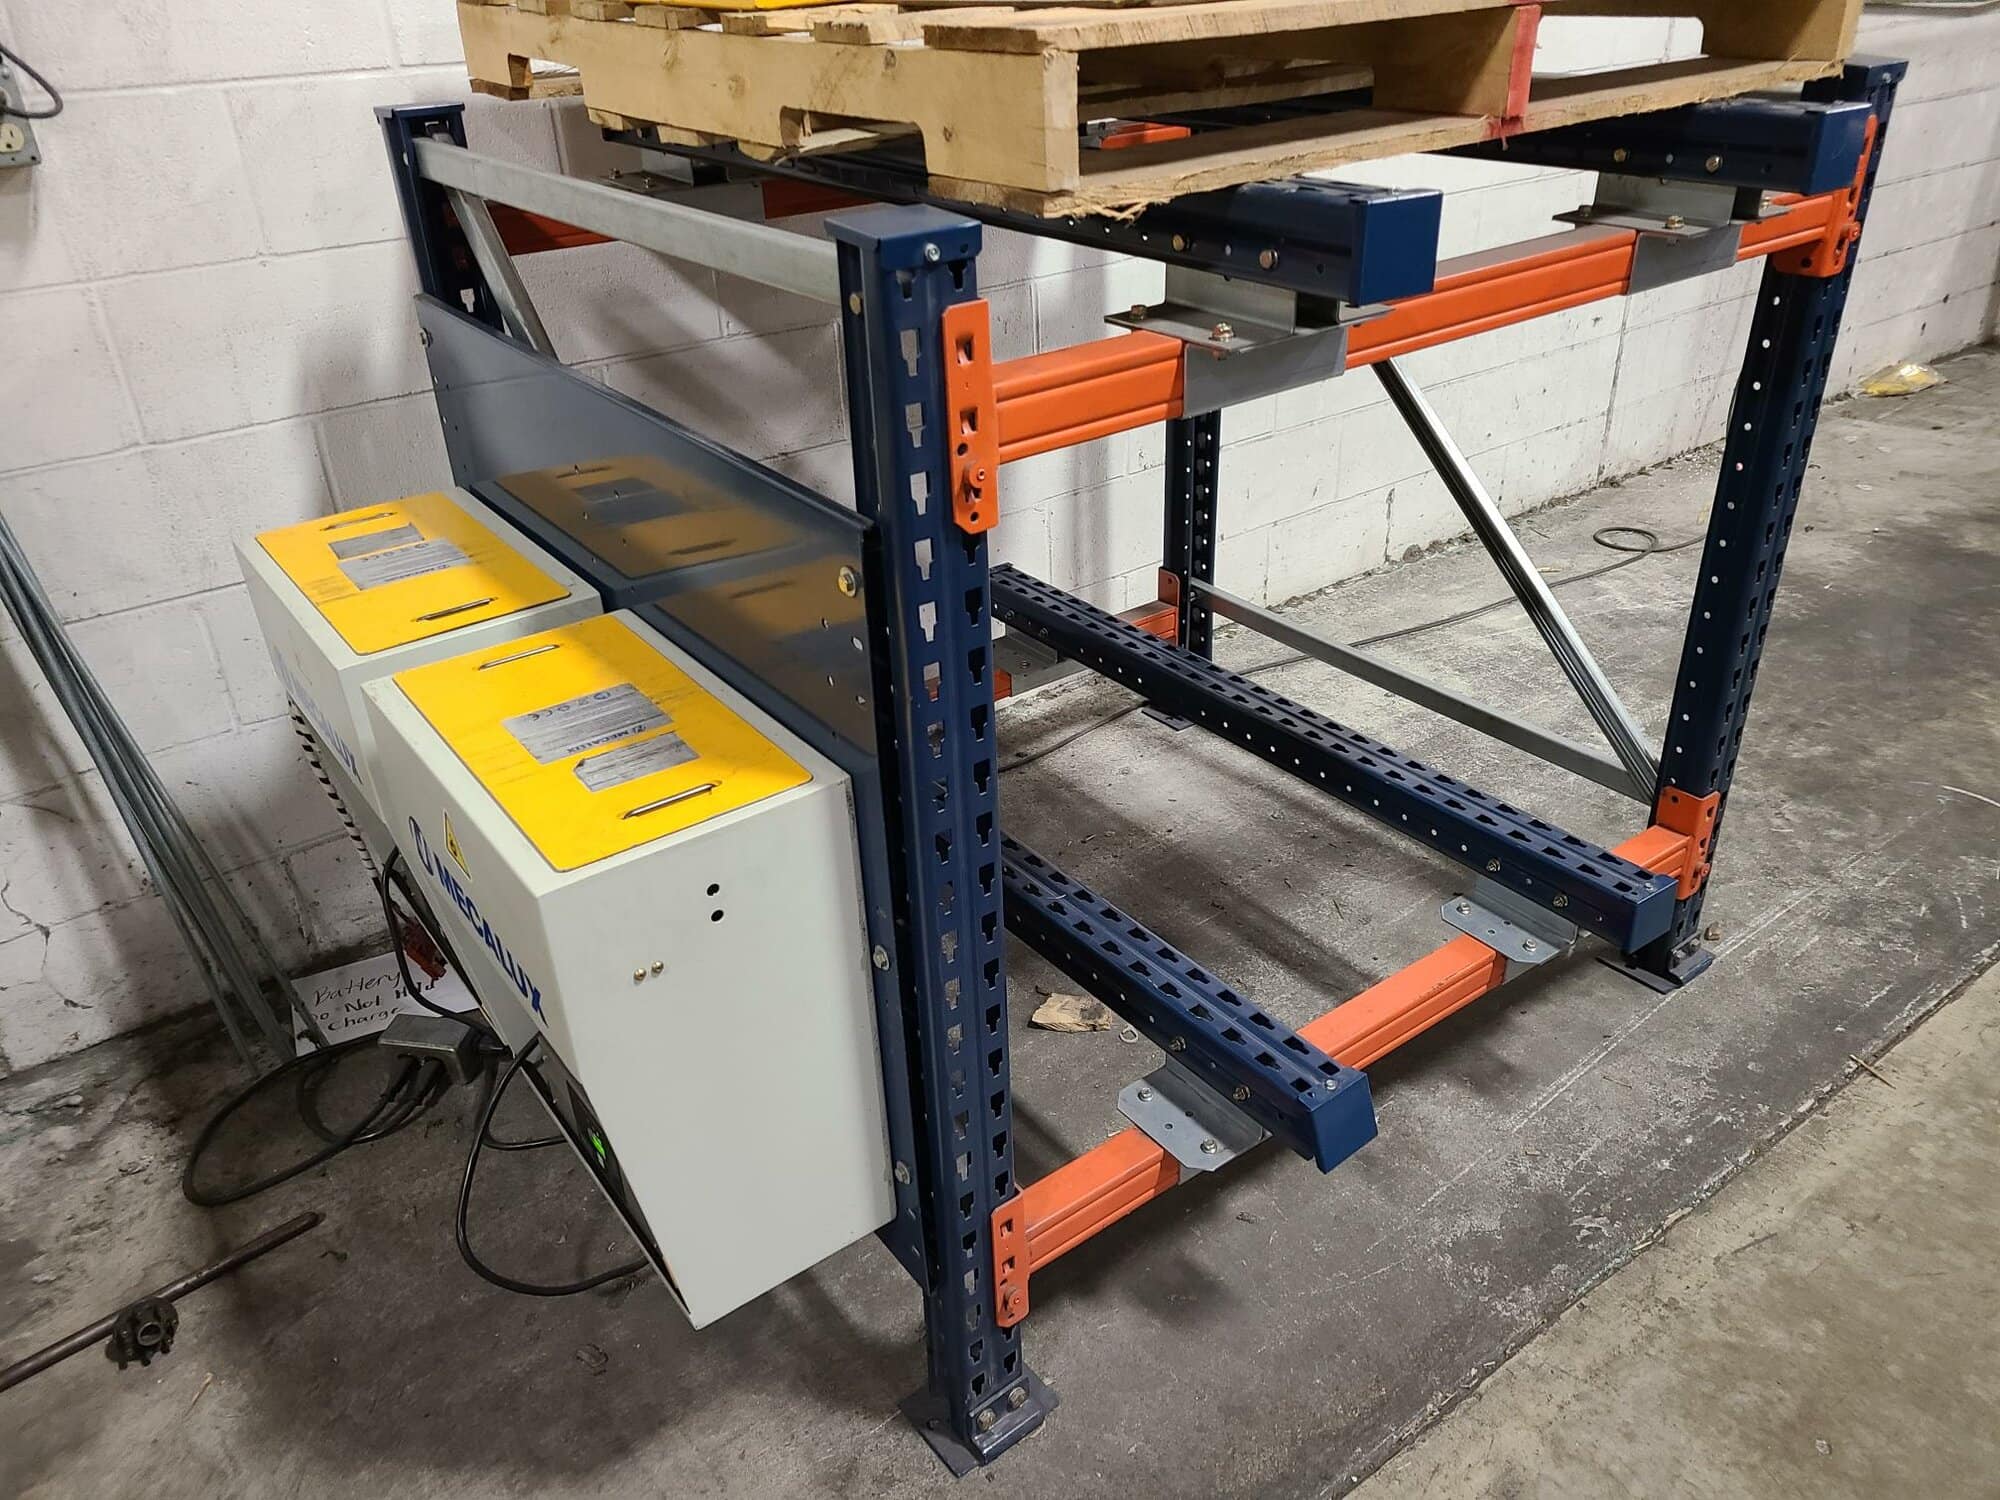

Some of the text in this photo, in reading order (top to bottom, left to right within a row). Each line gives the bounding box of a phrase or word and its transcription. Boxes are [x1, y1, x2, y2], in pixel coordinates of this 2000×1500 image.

[434, 852, 549, 1028] MECALUX
[315, 972, 401, 1006] Battery
[345, 995, 381, 1013] Not
[395, 981, 436, 999] Hld
